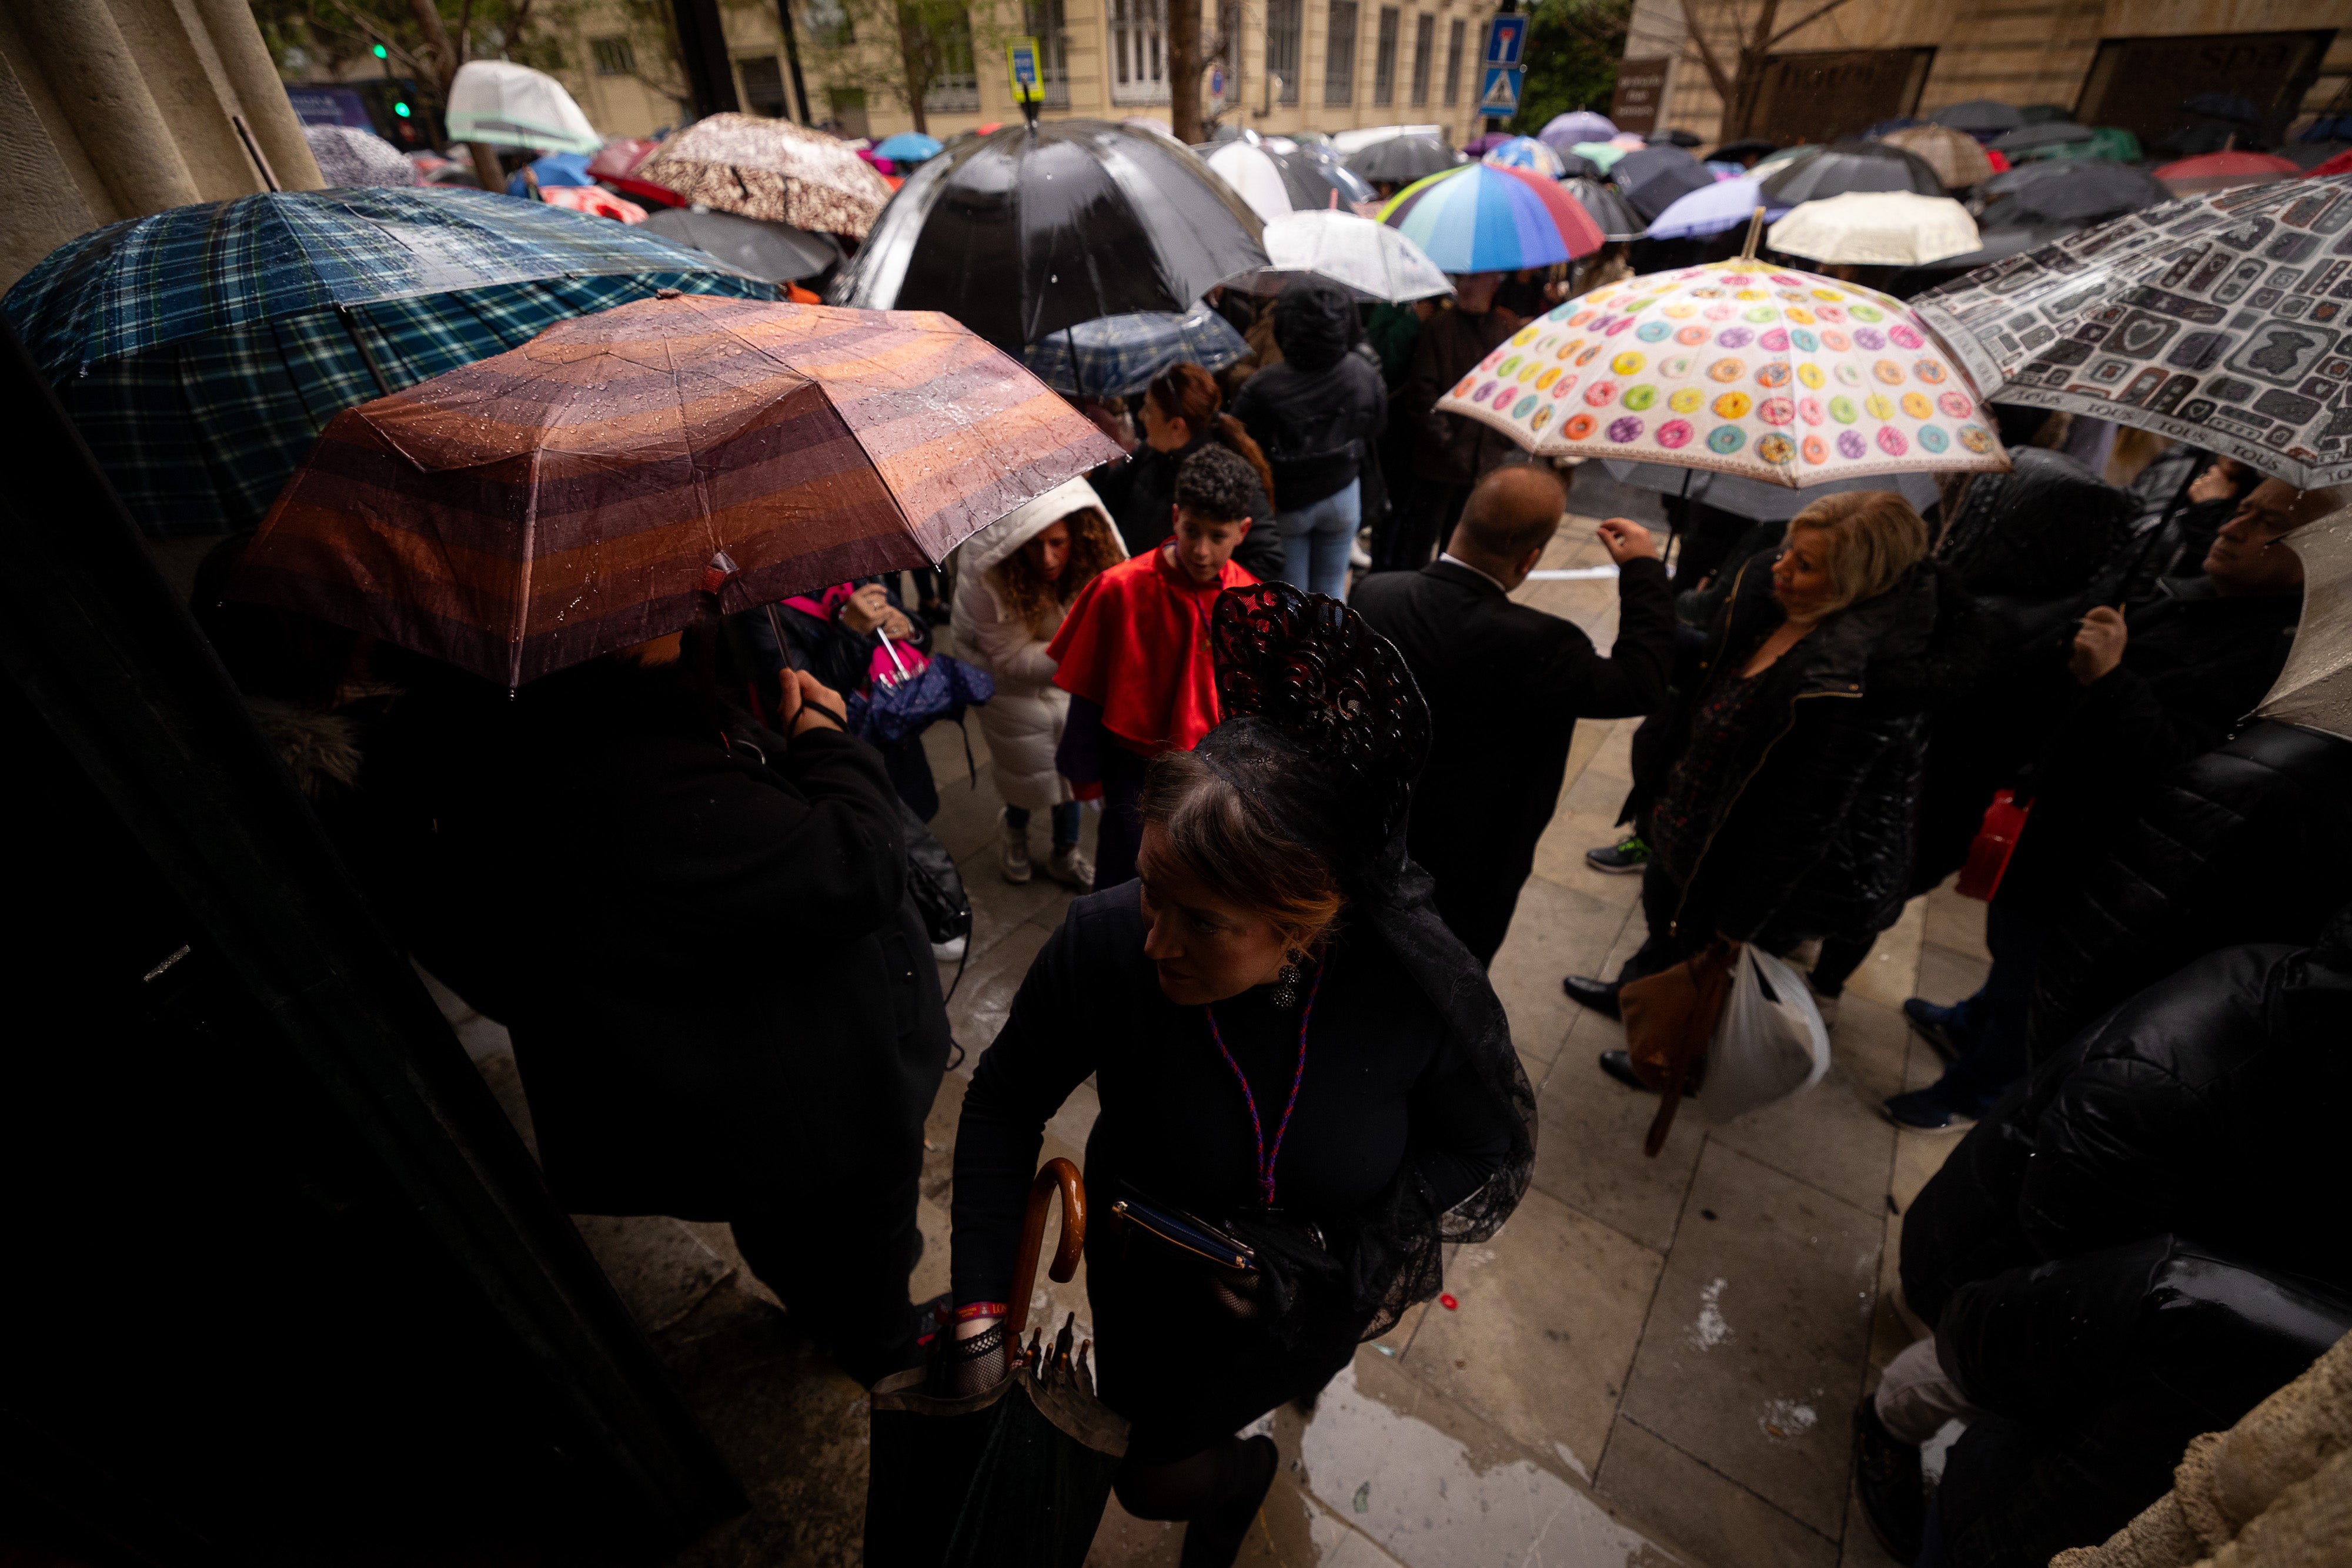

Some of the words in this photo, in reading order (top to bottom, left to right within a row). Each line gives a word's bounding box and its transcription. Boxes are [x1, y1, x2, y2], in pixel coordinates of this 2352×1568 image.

[2088, 404, 2133, 420] TOUS
[2159, 422, 2207, 442] TOUS
[2233, 446, 2279, 470] TOUS
